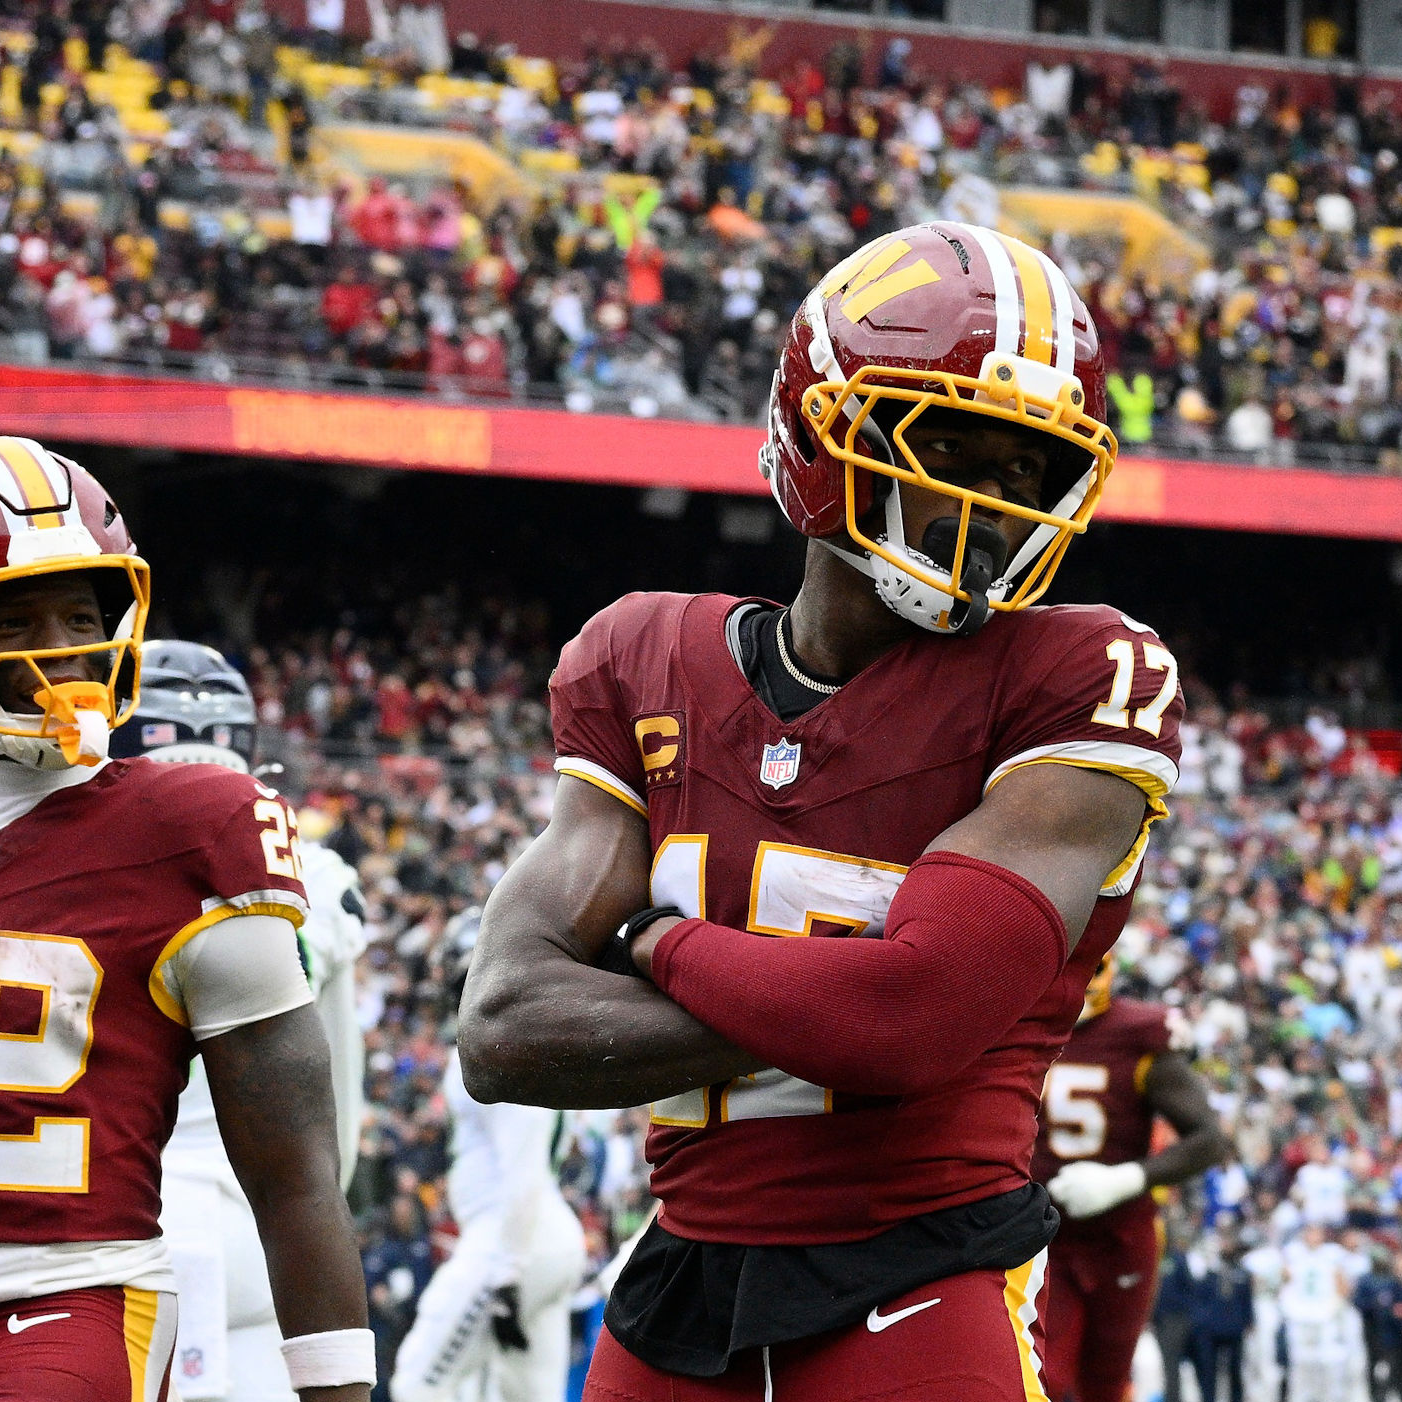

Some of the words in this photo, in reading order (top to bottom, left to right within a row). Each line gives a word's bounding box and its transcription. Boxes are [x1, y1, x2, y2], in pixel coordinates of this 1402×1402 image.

[1091, 638, 1178, 739] 17
[635, 715, 680, 771] C
[766, 762, 792, 780] NFL
